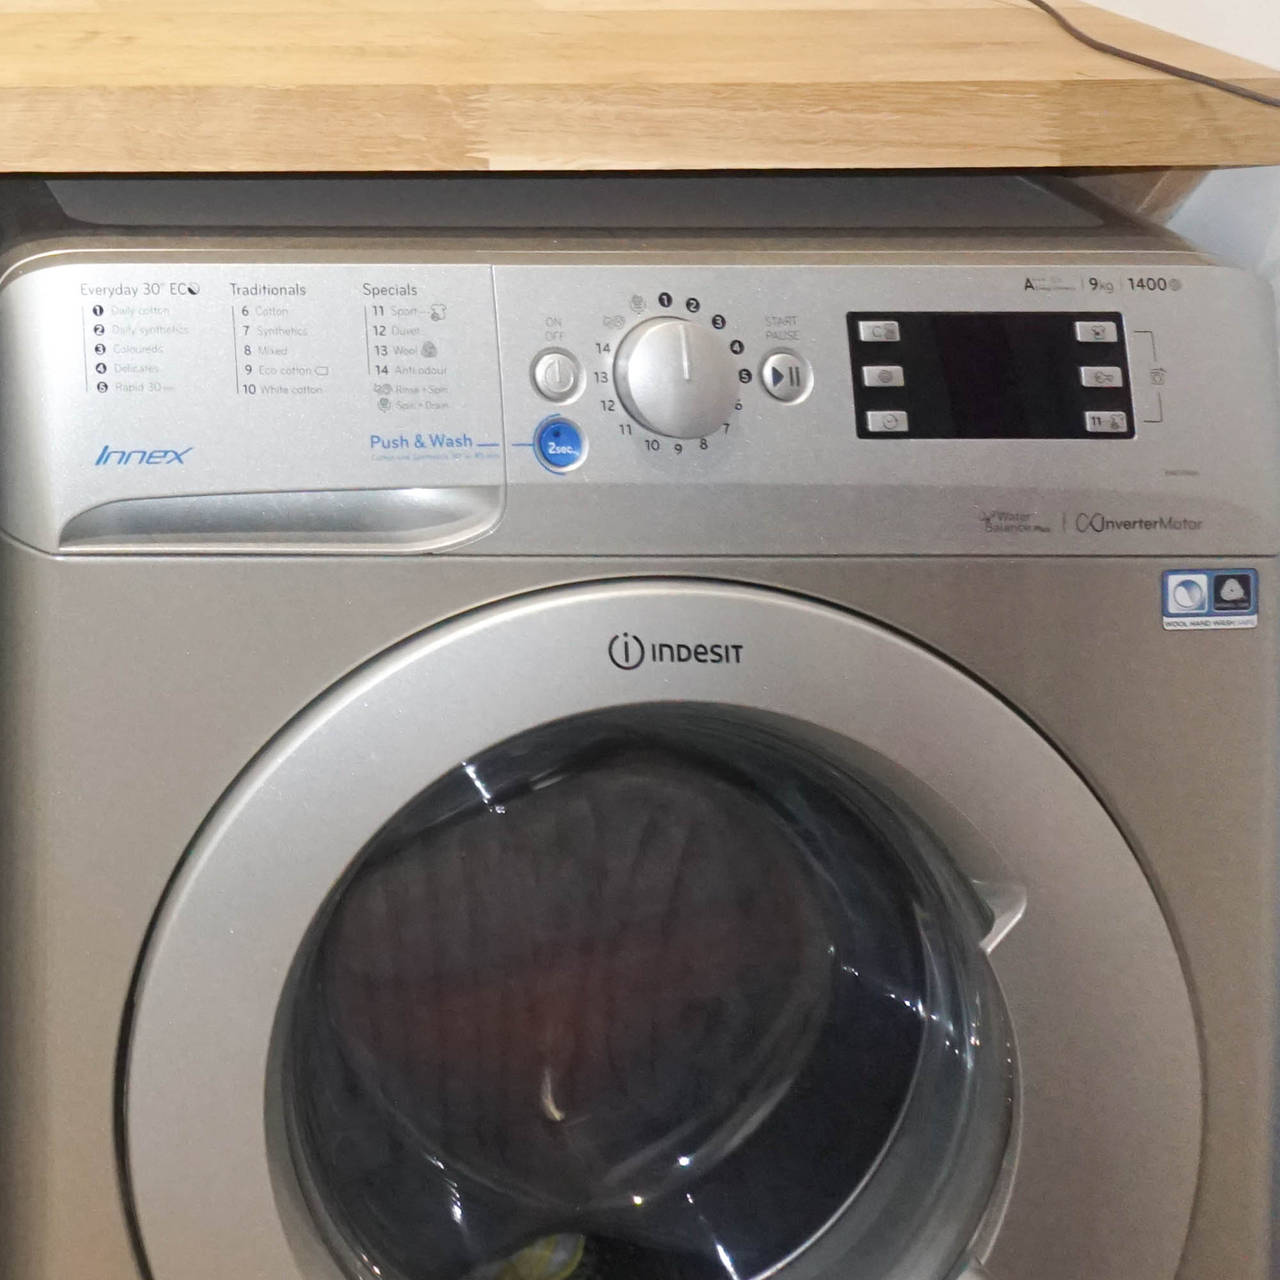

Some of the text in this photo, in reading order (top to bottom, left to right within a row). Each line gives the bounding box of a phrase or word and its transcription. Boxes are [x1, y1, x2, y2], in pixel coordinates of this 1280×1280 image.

[229, 283, 307, 296] Traditionals
[1128, 277, 1167, 291] 1400
[80, 282, 138, 298] Everyday
[362, 283, 418, 299] Specials
[242, 306, 249, 317] 6
[372, 305, 384, 316] 11
[243, 325, 250, 336] 7
[373, 325, 386, 336] 12
[244, 345, 251, 356] 8
[375, 345, 388, 356] 13
[595, 343, 611, 354] 14
[245, 365, 252, 375] 9
[376, 365, 388, 375] 14
[594, 372, 608, 383] 13
[243, 384, 256, 395] 10
[600, 400, 615, 412] 12
[619, 424, 632, 435] 11
[723, 423, 730, 434] 7
[370, 433, 473, 449] Push & Wash
[645, 439, 660, 451] 10
[700, 438, 708, 450] 8
[674, 444, 683, 455] 9
[95, 445, 194, 466] Innex
